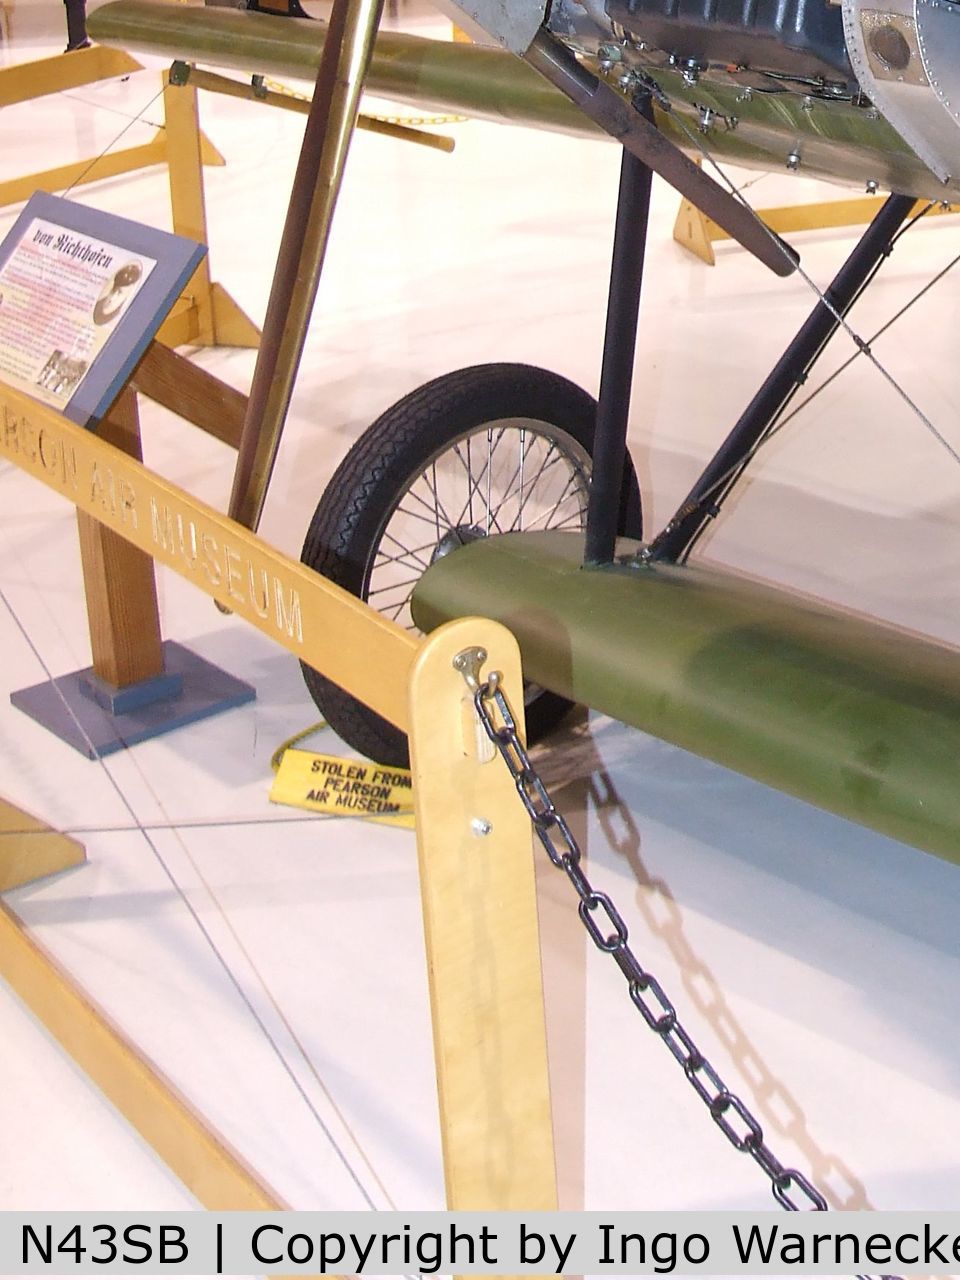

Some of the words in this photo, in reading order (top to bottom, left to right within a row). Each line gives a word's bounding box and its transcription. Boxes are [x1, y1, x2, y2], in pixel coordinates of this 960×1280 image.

[32, 228, 54, 248] von
[53, 233, 113, 269] Richthofen
[90, 460, 139, 530] AIR
[150, 495, 304, 644] MUSEUM
[311, 760, 368, 781] STOLEN
[372, 770, 412, 790] FROM
[323, 777, 392, 800] PEARSON
[306, 789, 330, 804] AIR
[335, 793, 400, 813] MUSEUM
